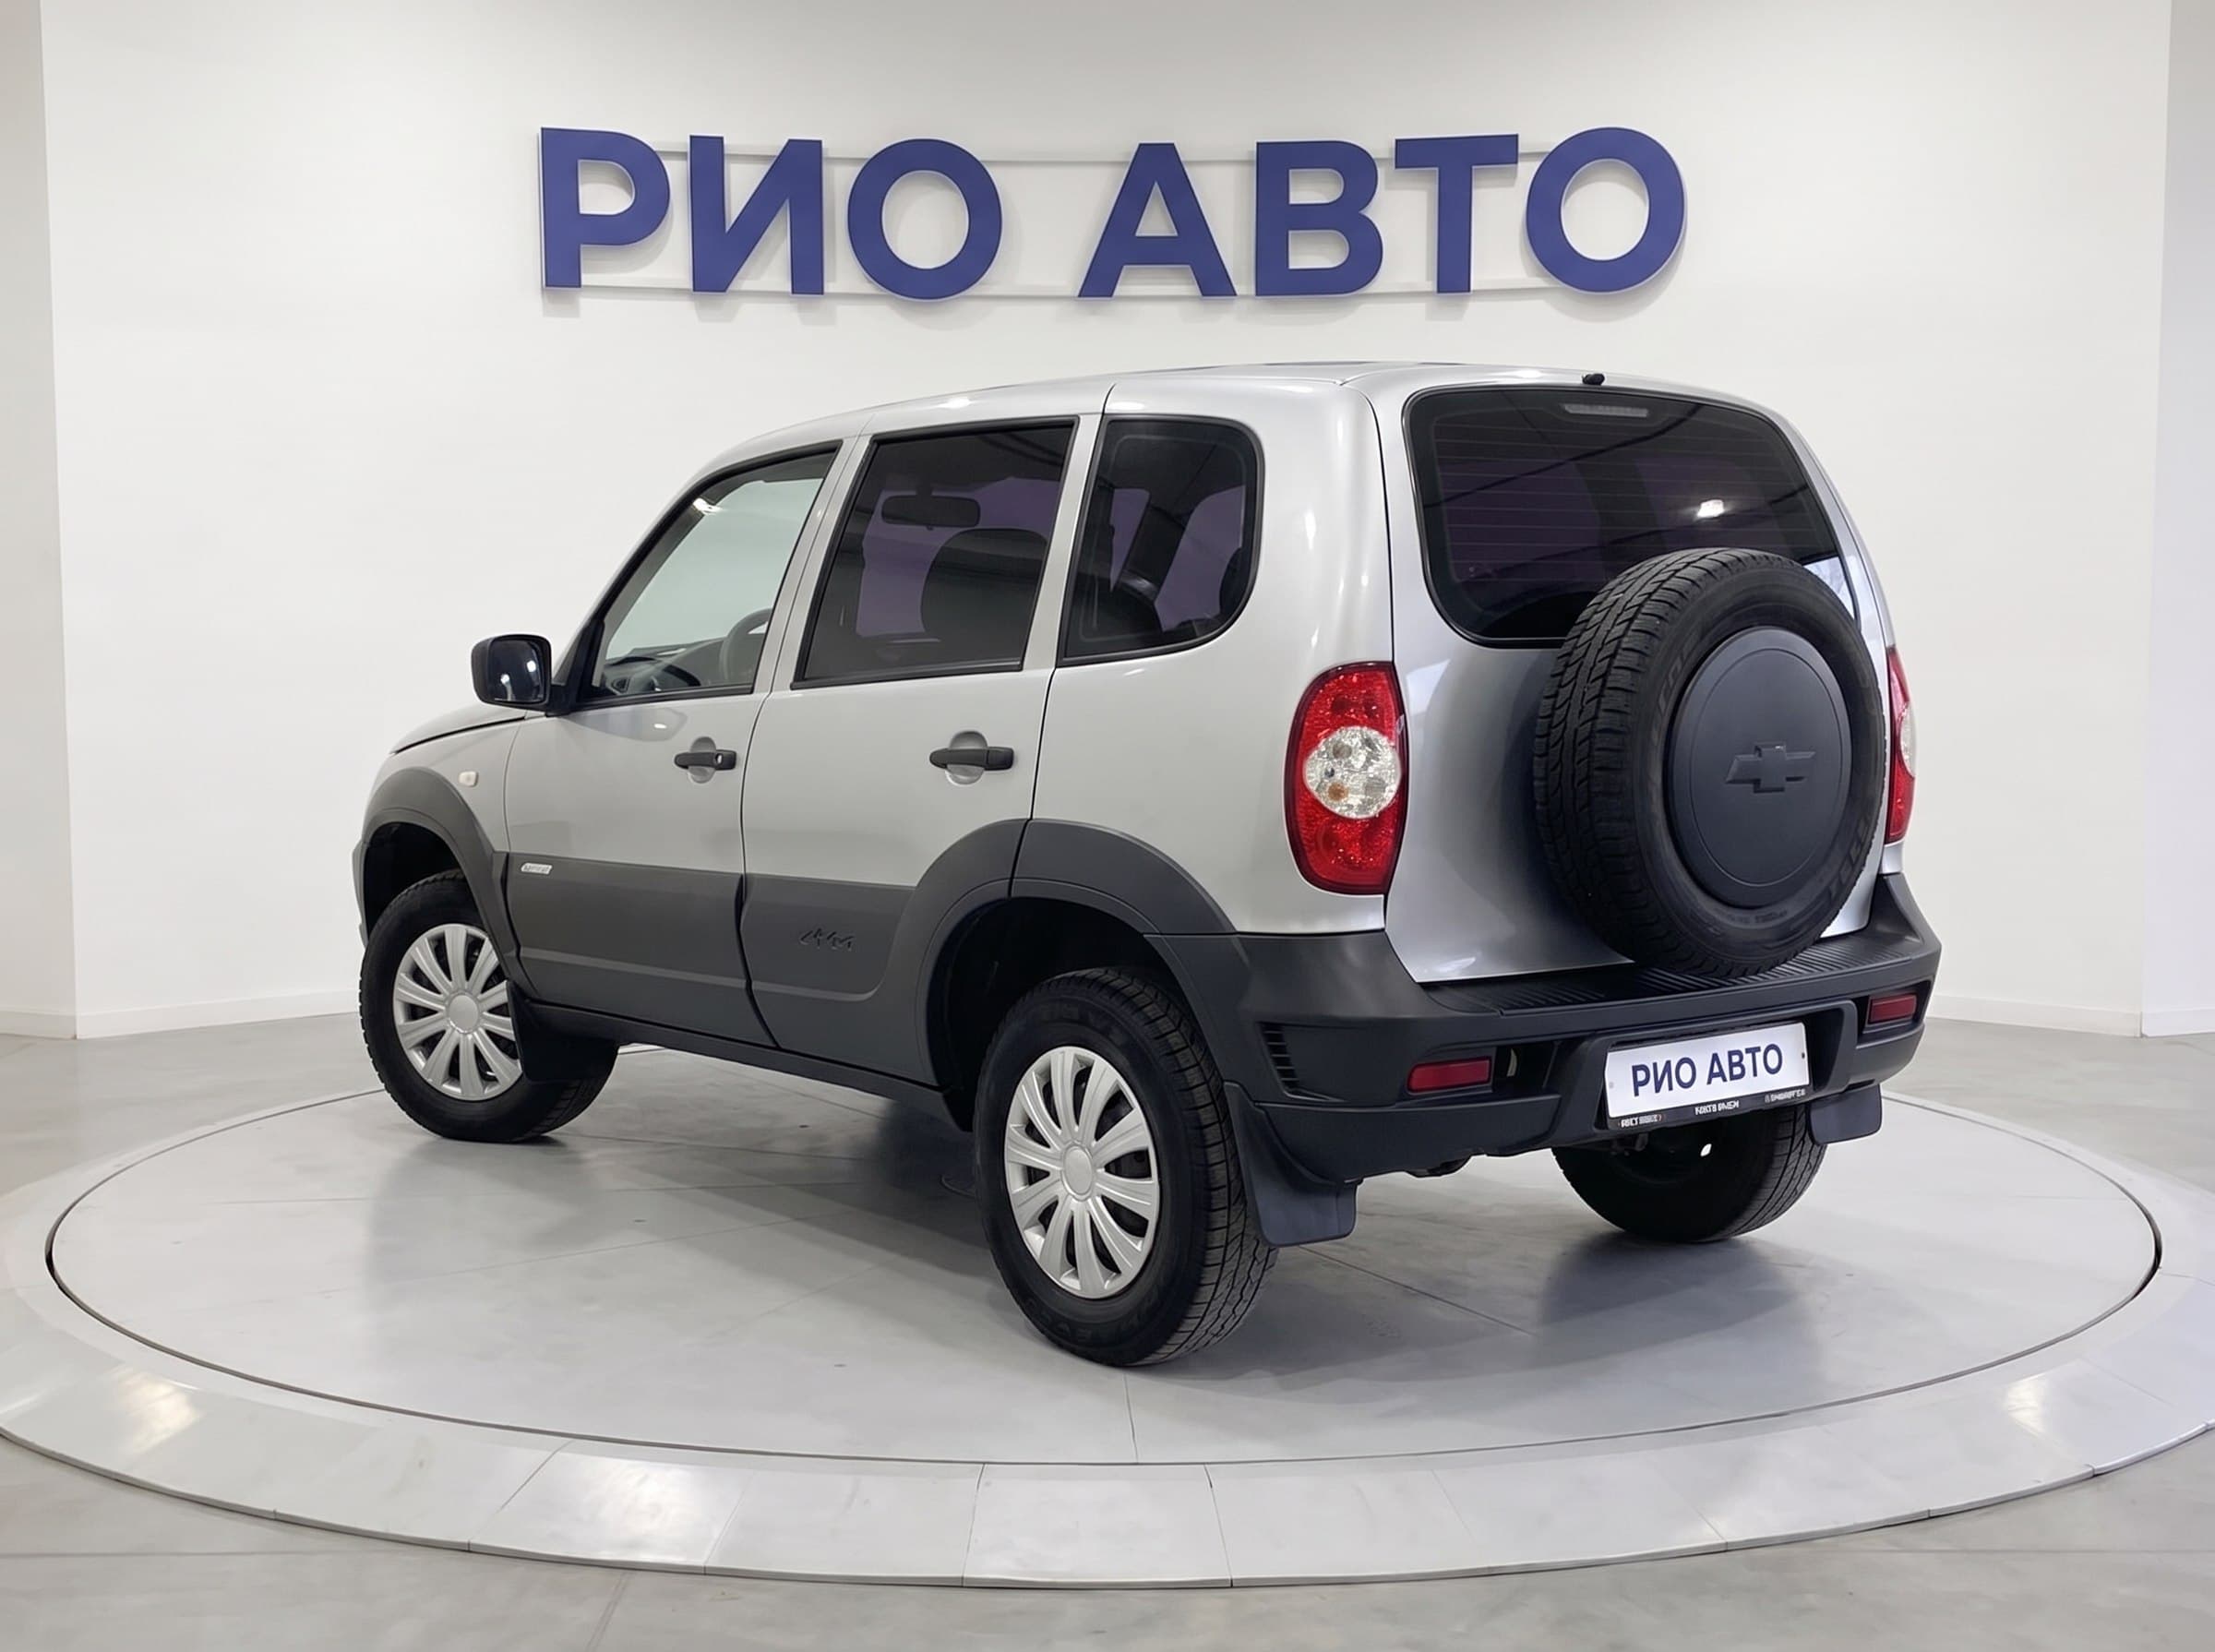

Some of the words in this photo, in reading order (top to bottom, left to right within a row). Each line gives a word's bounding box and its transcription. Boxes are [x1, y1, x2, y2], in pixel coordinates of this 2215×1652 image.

[541, 127, 1004, 301] РИО
[1077, 126, 1685, 298] АВТО
[1631, 1057, 1696, 1096] РИО
[1706, 1043, 1783, 1084] АВТО
